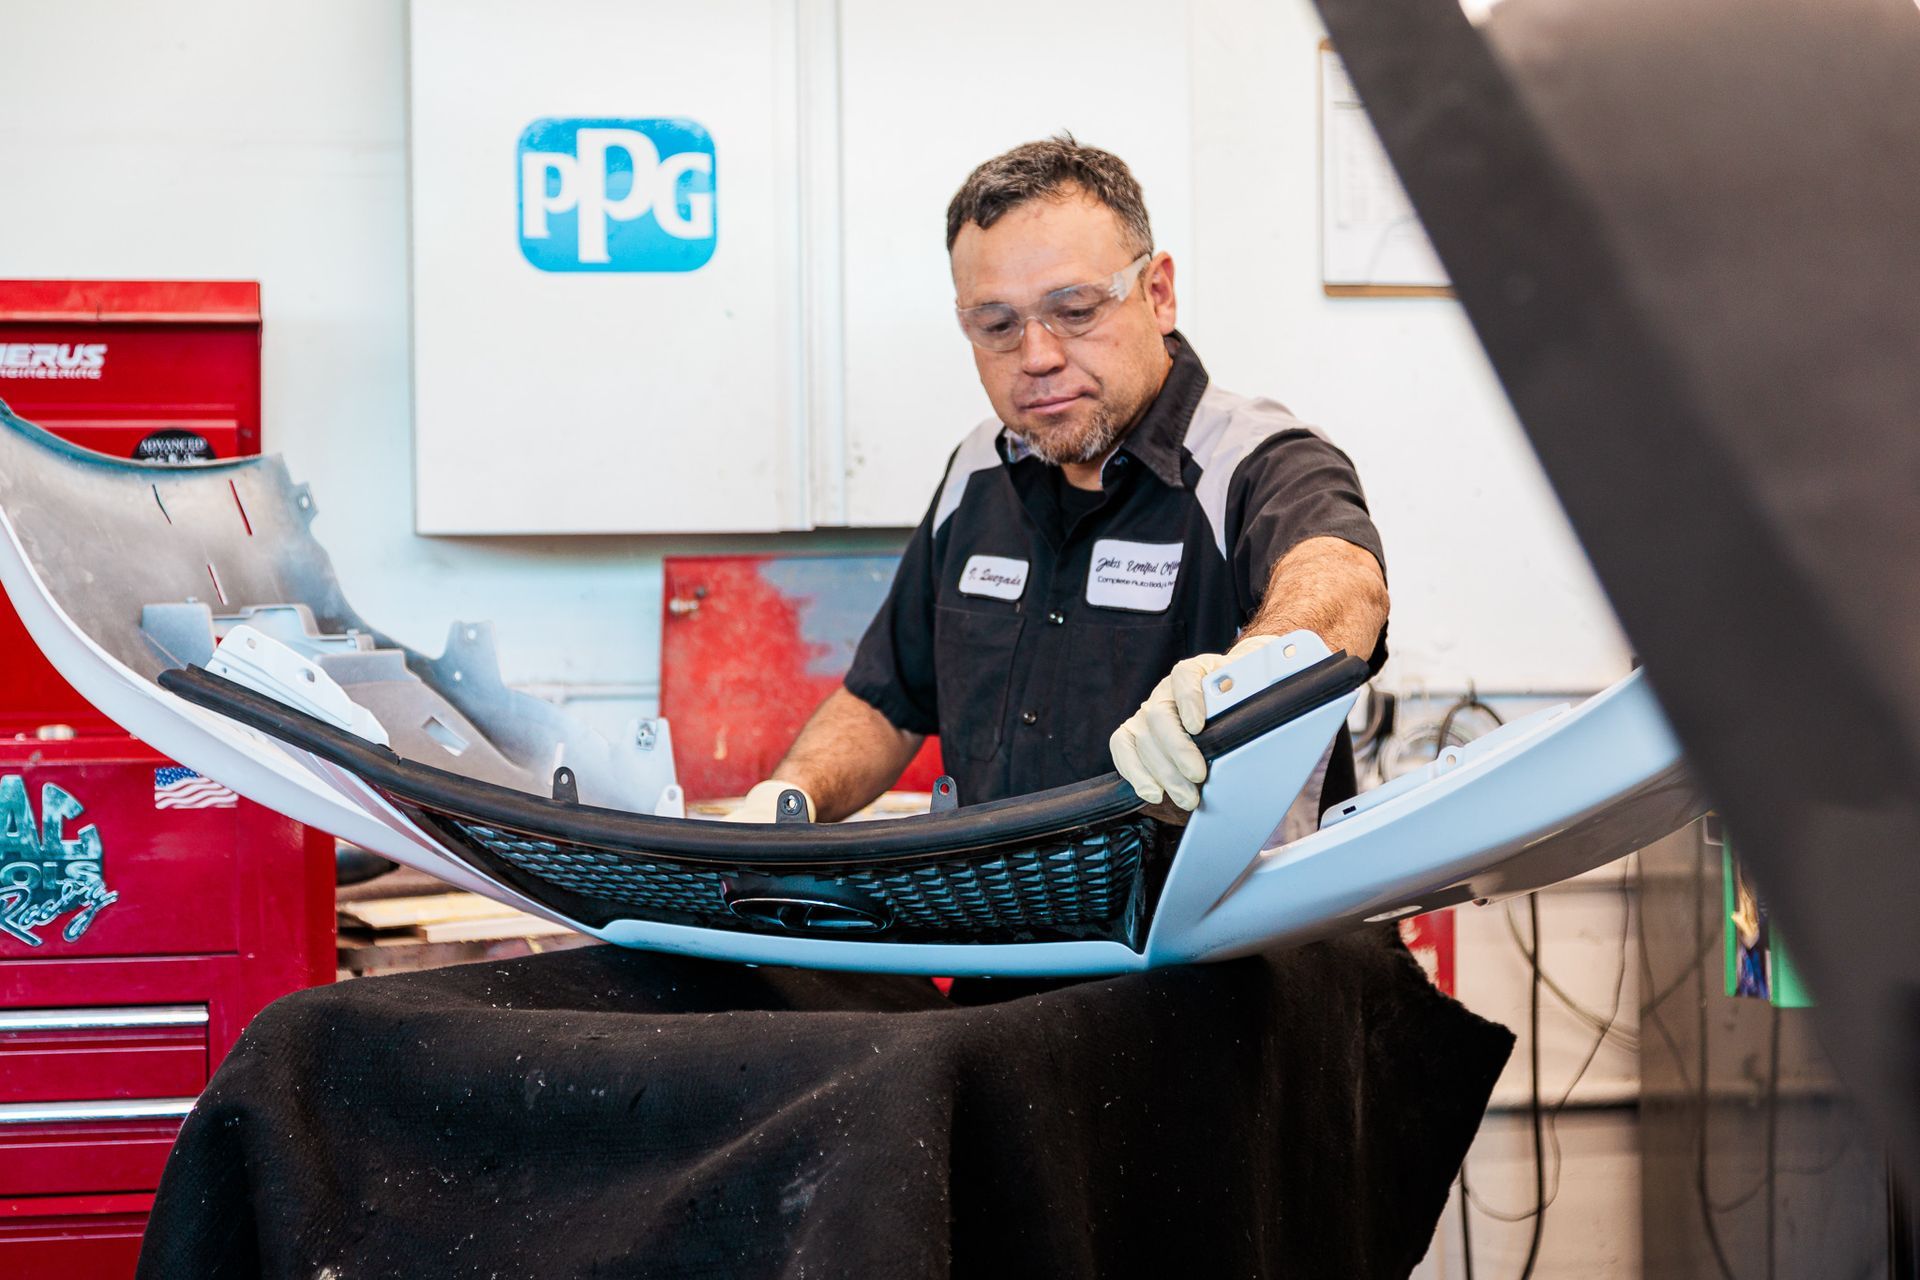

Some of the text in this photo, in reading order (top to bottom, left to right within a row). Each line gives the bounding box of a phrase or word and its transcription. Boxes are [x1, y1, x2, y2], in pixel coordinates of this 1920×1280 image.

[522, 128, 713, 263] PPG
[139, 436, 208, 451] ADVANCED
[1097, 575, 1131, 586] Complete
